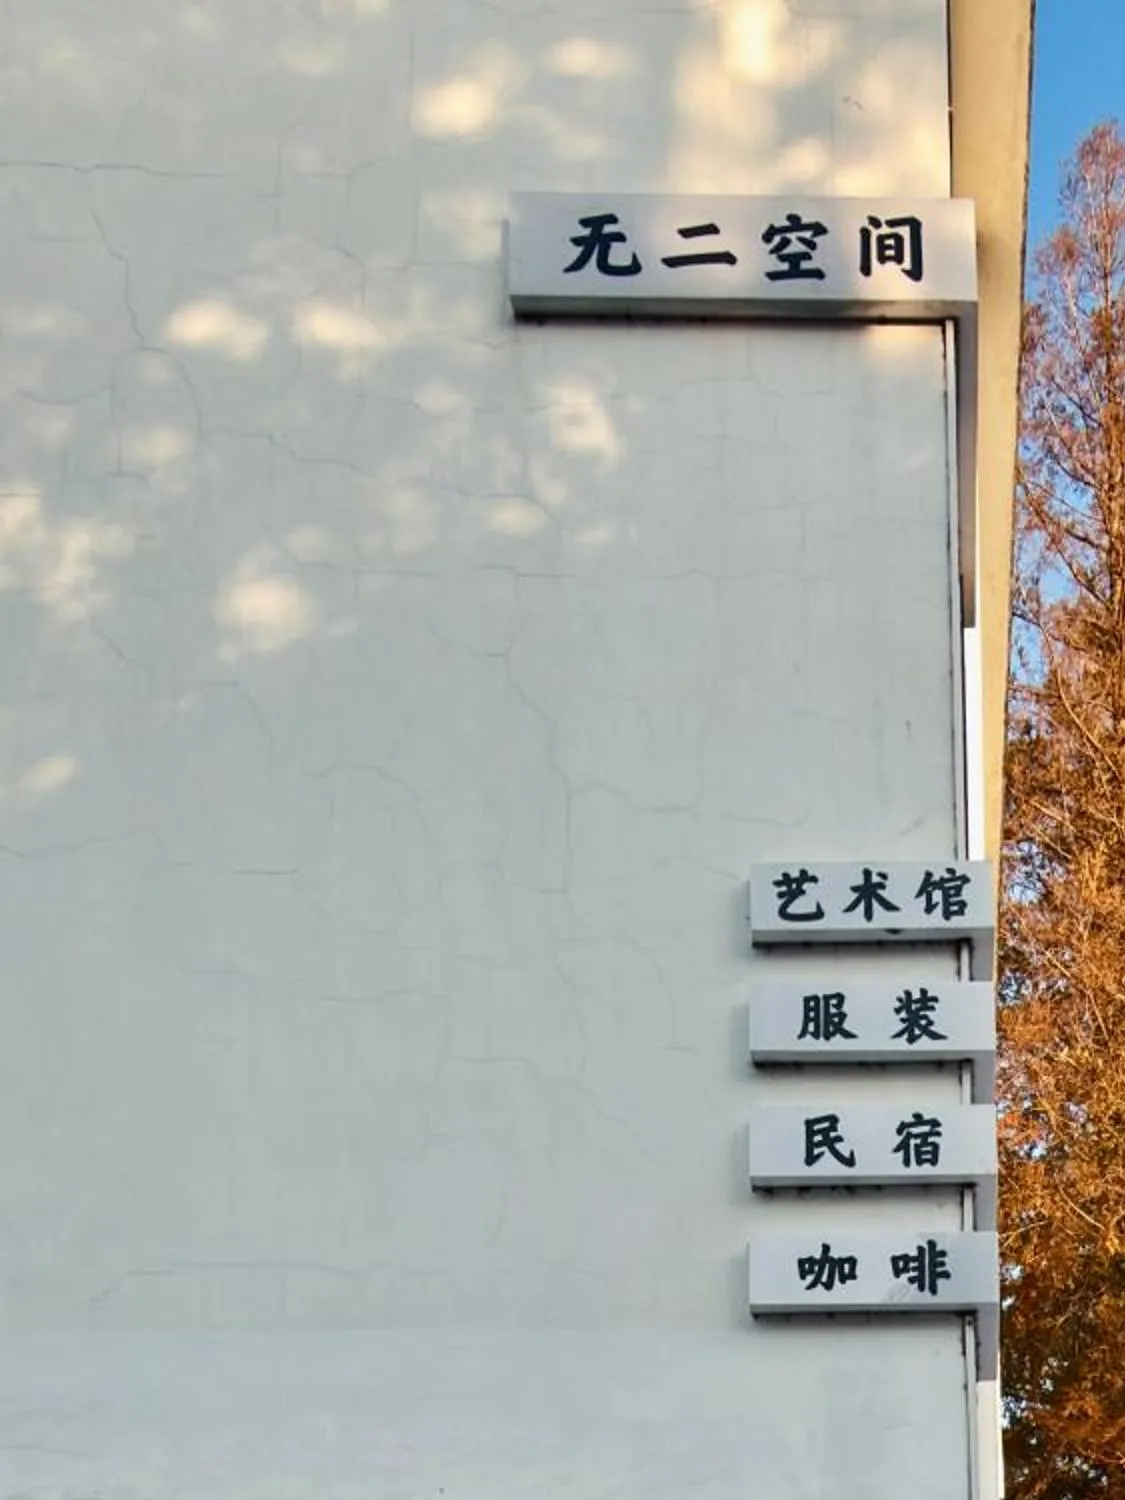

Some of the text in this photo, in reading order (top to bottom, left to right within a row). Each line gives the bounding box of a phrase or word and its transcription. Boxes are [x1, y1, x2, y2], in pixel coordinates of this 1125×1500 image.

[562, 212, 924, 283] 无二空间
[772, 867, 972, 923] 艺术馆
[796, 987, 948, 1045] 服装
[802, 1111, 944, 1169] 民宿
[796, 1239, 952, 1297] 咖啡
